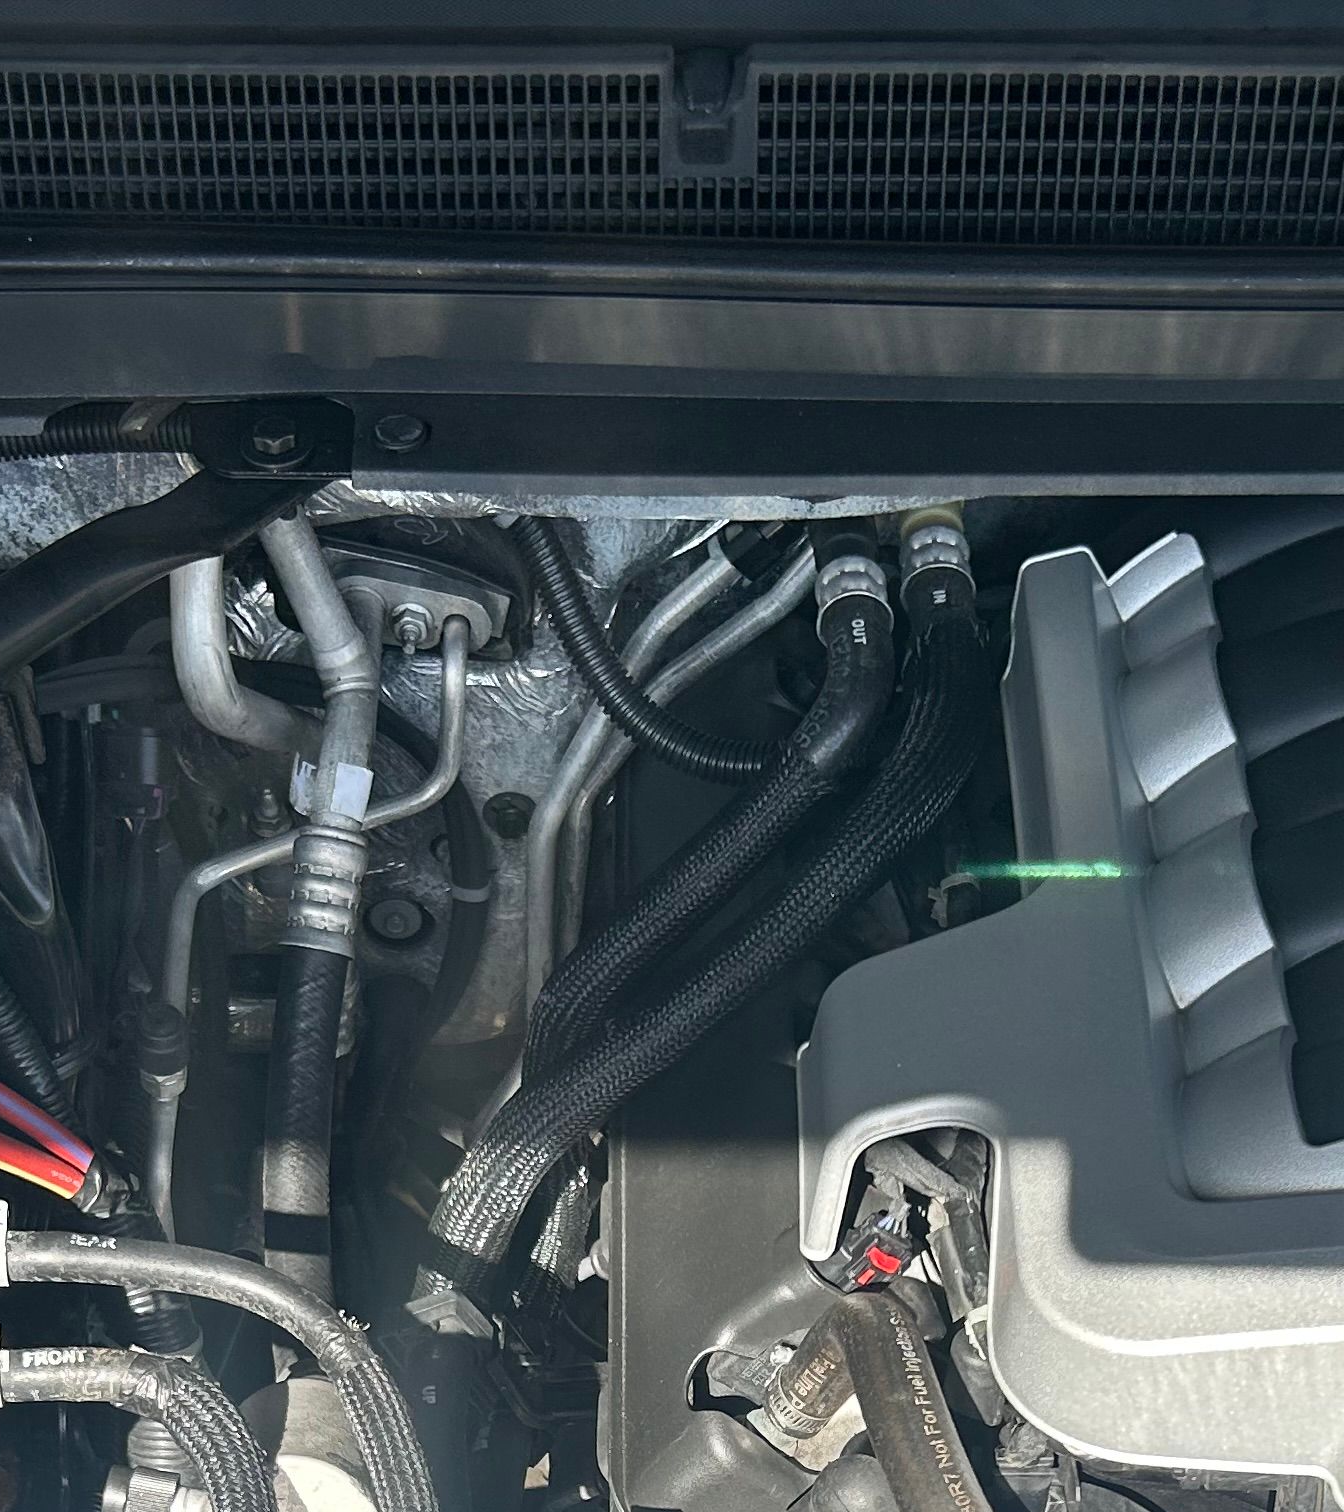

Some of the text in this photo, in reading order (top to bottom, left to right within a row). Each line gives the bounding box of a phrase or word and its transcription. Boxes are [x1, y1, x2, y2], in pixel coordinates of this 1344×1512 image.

[931, 588, 947, 605] IN
[850, 618, 867, 645] OUT
[22, 1348, 88, 1369] FRONT
[791, 1368, 823, 1400] Line
[910, 1376, 934, 1407] Fuel
[923, 1413, 942, 1437] For
[933, 1440, 955, 1469] Not
